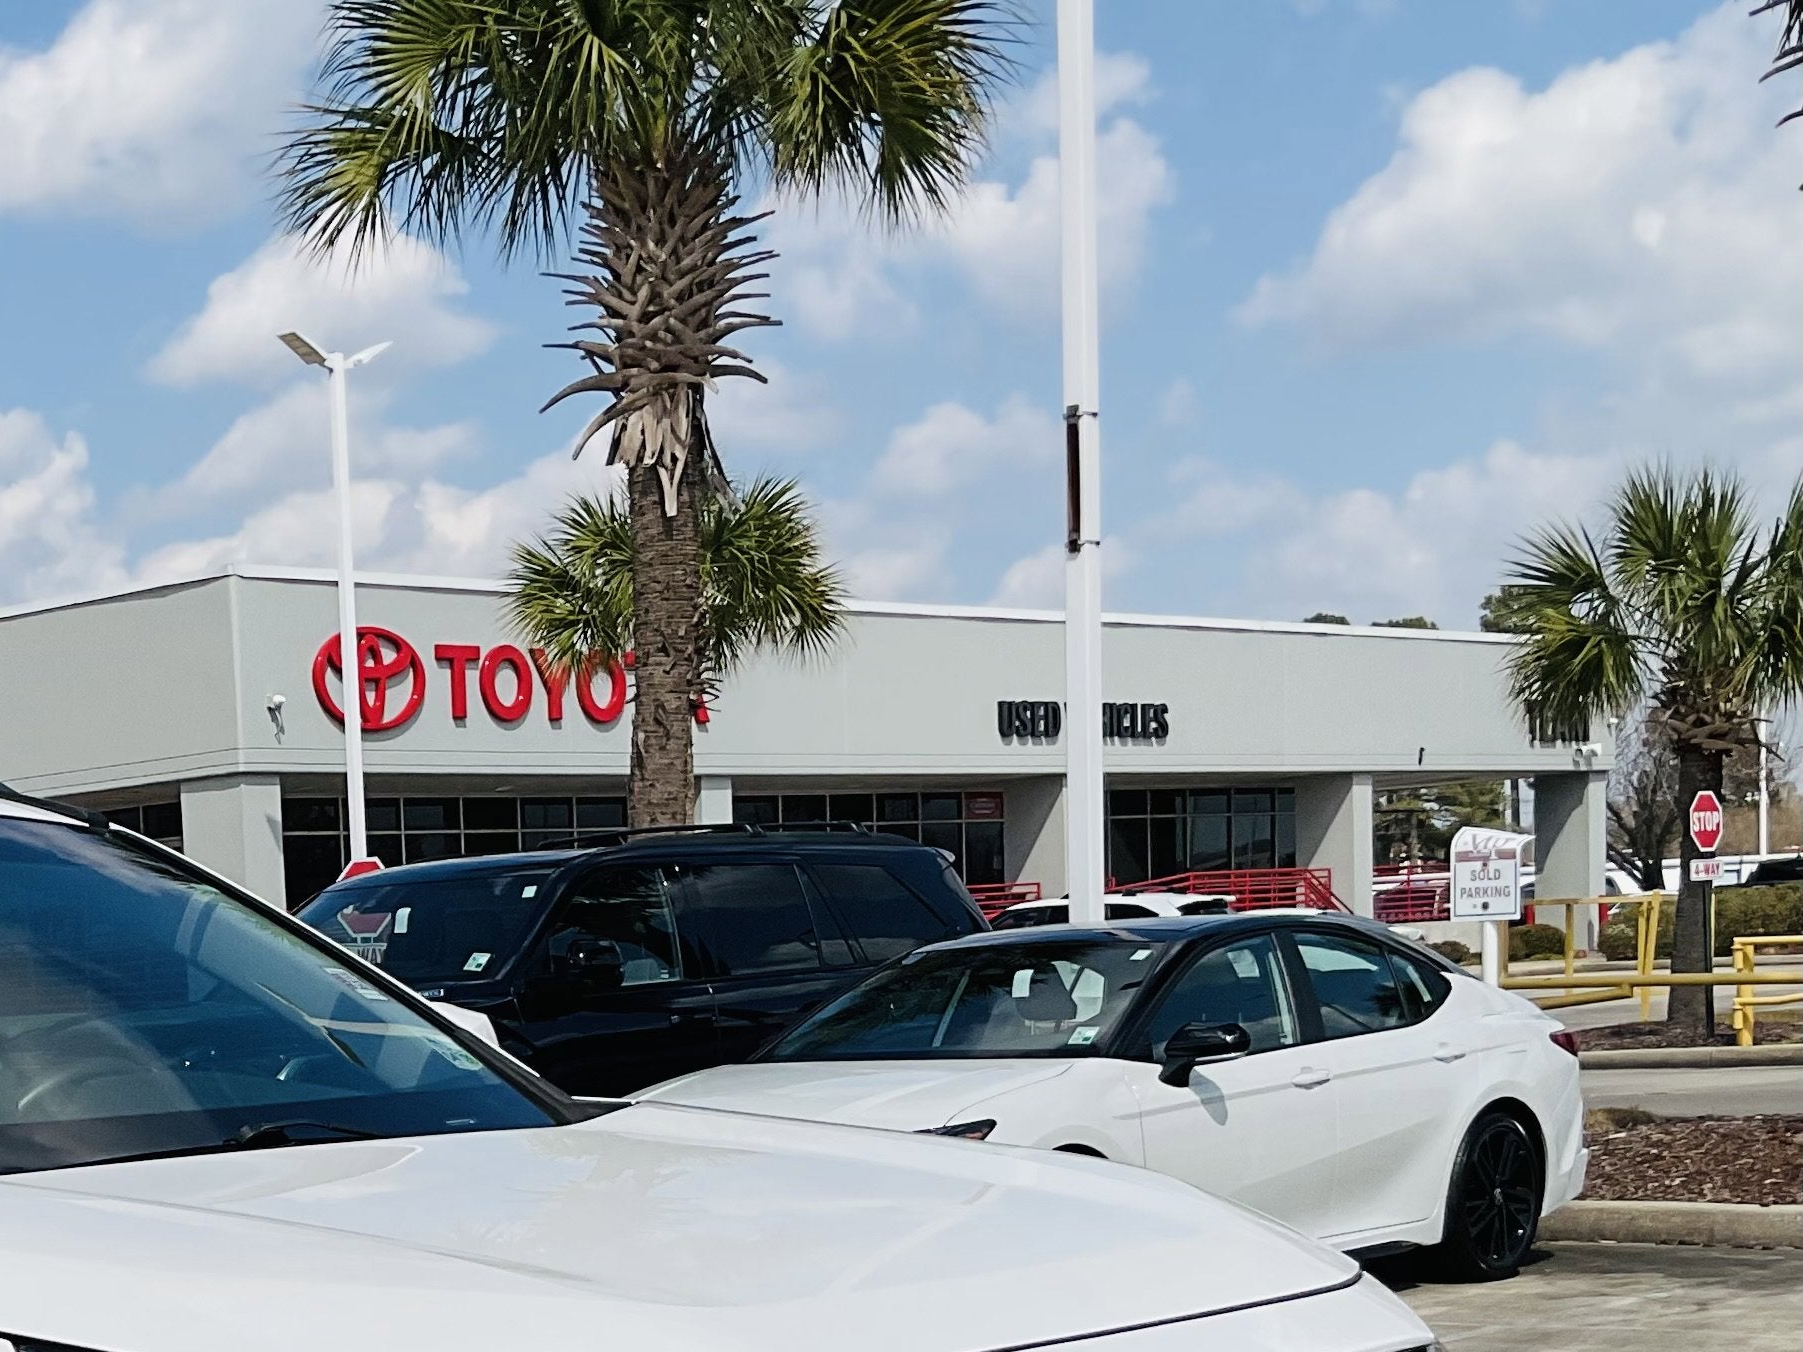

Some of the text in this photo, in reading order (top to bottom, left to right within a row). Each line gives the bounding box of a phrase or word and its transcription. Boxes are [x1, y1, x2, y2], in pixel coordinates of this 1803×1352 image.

[434, 644, 710, 724] TOYO
[997, 700, 1061, 738] USED
[1693, 811, 1720, 833] STOP
[1470, 869, 1501, 882] SOLD
[1694, 862, 1720, 876] 4-WAY
[1460, 886, 1511, 900] PARKING
